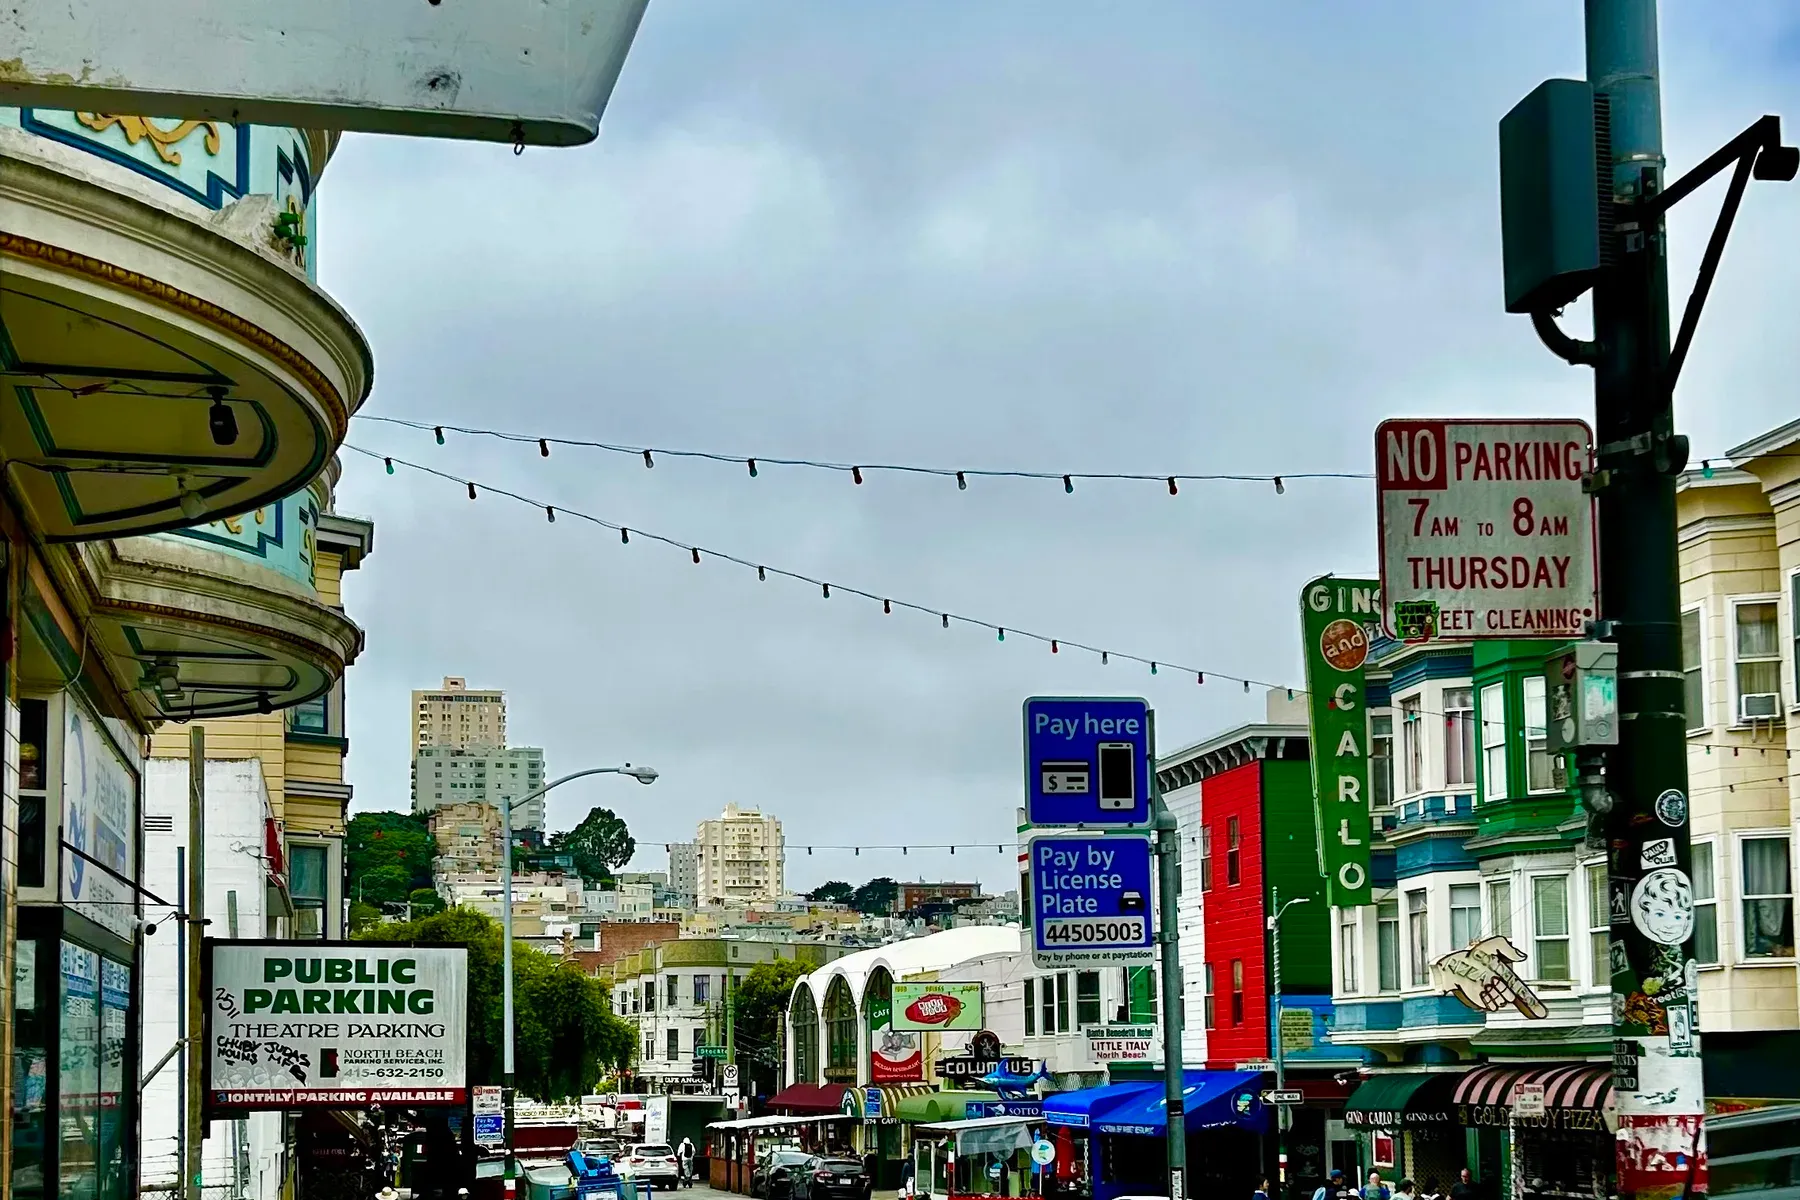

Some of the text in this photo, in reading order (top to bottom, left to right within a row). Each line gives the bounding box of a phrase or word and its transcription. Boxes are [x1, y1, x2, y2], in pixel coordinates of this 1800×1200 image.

[1386, 428, 1583, 482] NO PARKING
[1477, 523, 1494, 537] TO
[1407, 556, 1572, 590] THURSDAY
[1441, 608, 1582, 630] EET CLEANING
[1326, 630, 1364, 656] and
[1035, 712, 1140, 740] Pay here
[1334, 682, 1366, 891] CARLO
[1040, 845, 1115, 872] Pay by
[1041, 869, 1122, 890] License
[1042, 893, 1098, 914] Plate
[1045, 922, 1143, 943] 44505003
[1037, 953, 1052, 962] Pay
[1053, 952, 1064, 962] by
[1065, 951, 1092, 962] phone
[1101, 951, 1111, 959] at
[1111, 950, 1153, 961] paystation
[264, 957, 417, 985] PUBLIC
[243, 988, 434, 1015] PARKING
[228, 1023, 446, 1038] THEATRE PARKING
[343, 1049, 444, 1059] NORTH BEACH
[1091, 1041, 1151, 1051] LITTLE ITALY
[1122, 1051, 1147, 1059] Beach
[343, 1067, 444, 1078] 415-632-2150
[945, 1060, 1034, 1076] COLUMUS
[228, 1091, 454, 1103] ONTHLY PARKING AVAILABLE
[1008, 1107, 1039, 1116] SOTTO
[1562, 1109, 1604, 1131] PIZZA
